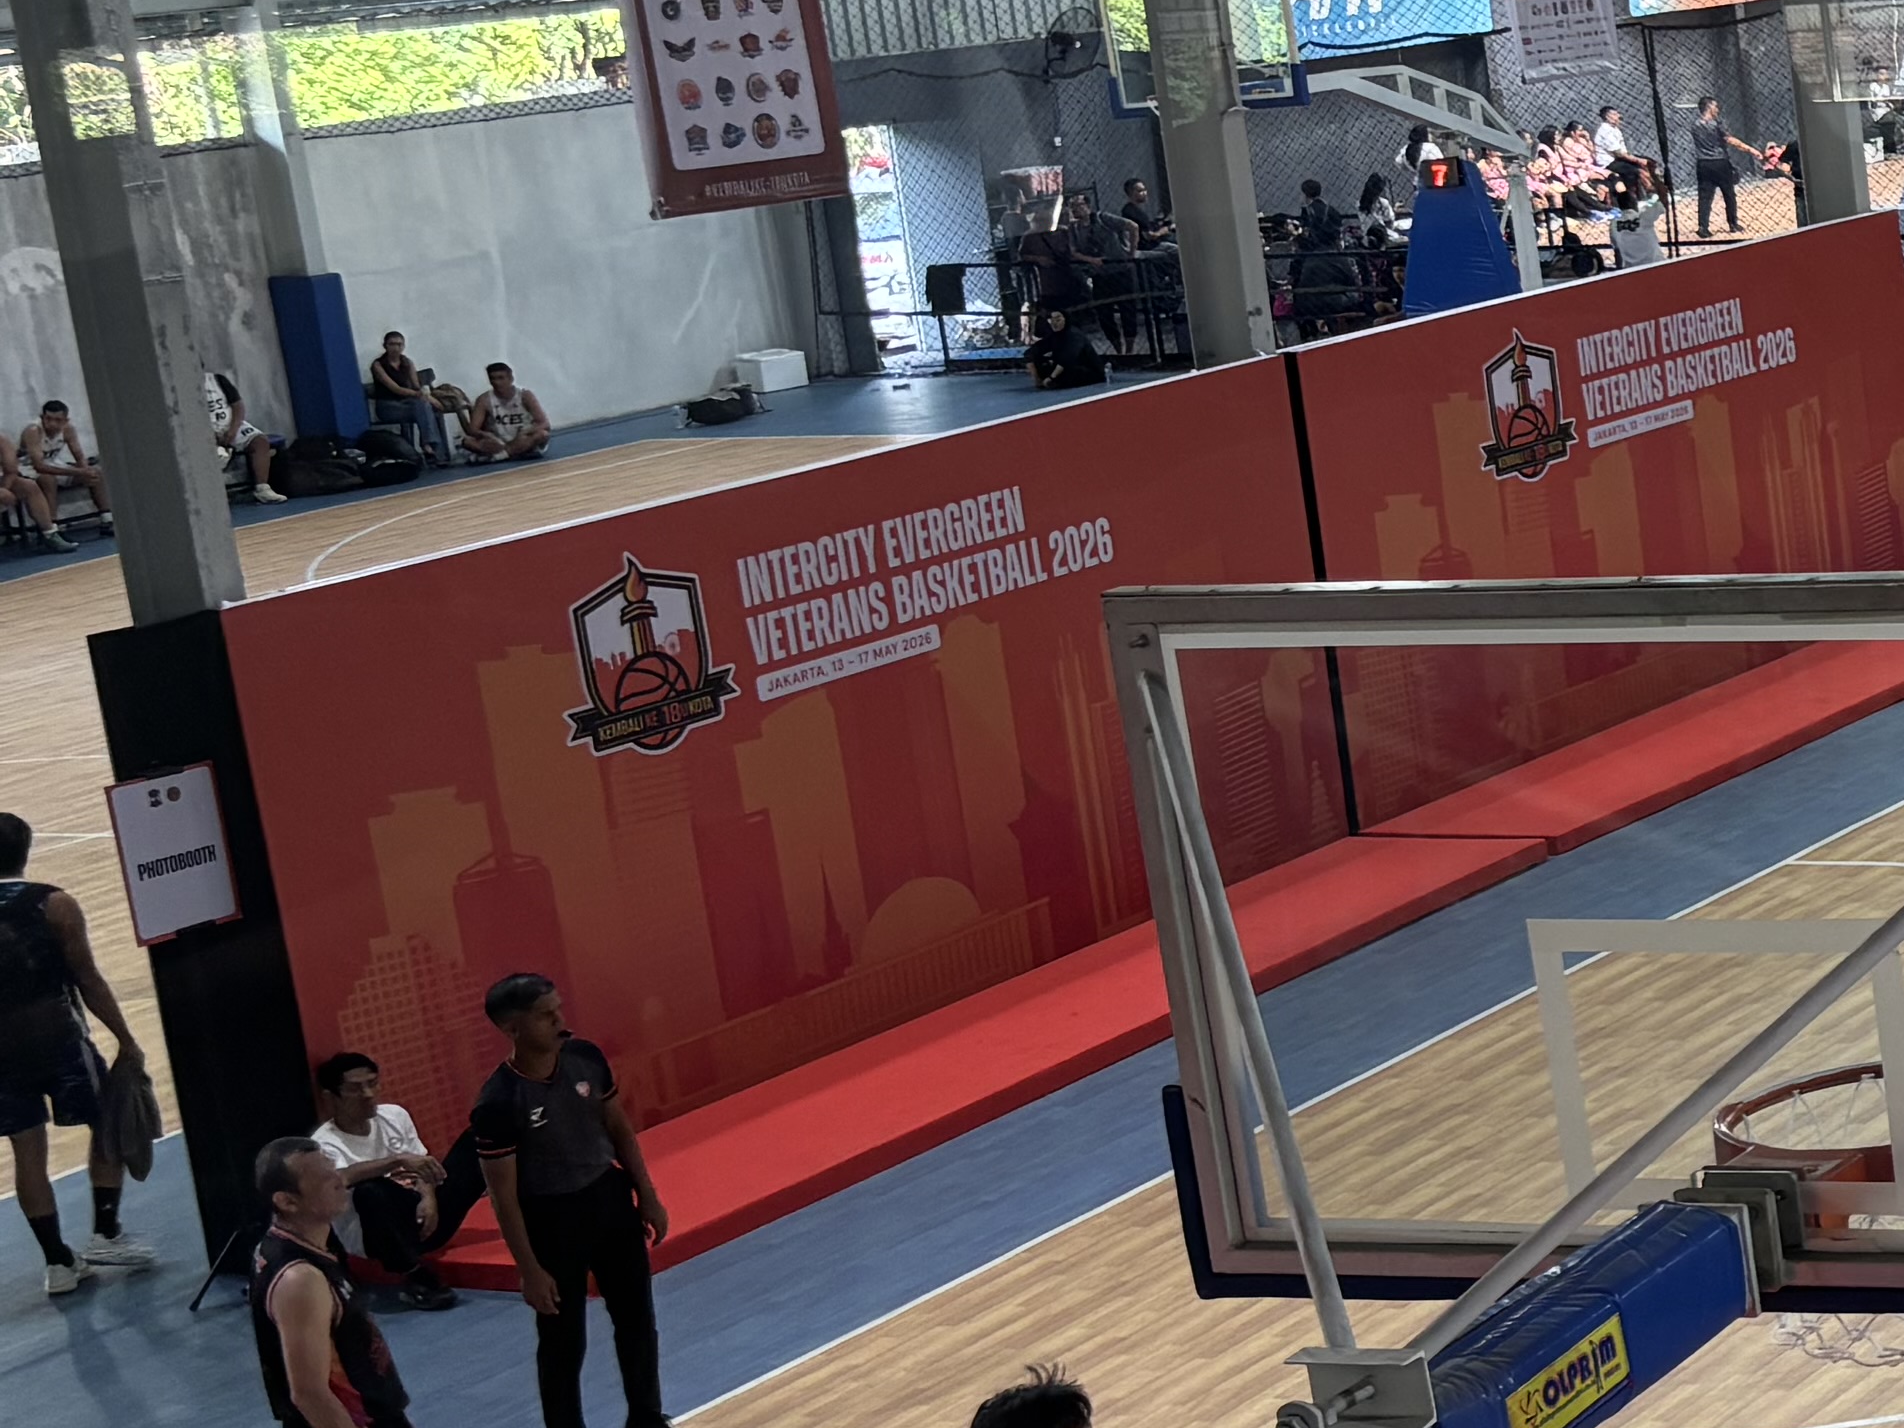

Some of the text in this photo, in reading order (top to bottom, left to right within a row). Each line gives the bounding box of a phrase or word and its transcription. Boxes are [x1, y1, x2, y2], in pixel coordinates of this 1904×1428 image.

[1576, 297, 1744, 376] INTERCITY EVERGREEN
[1581, 326, 1797, 421] VETERANS BASKETBALL 2026
[736, 485, 1026, 608] INTERCITY EVERGREEN
[746, 517, 1115, 666] VETERANS BASKETBALL 2026
[767, 665, 829, 693] JAKARTA,
[831, 659, 845, 673] 13
[857, 651, 870, 665] 17
[872, 642, 900, 663] MAY
[902, 631, 933, 653] 2026
[136, 843, 218, 883] PHOTOBOOTH
